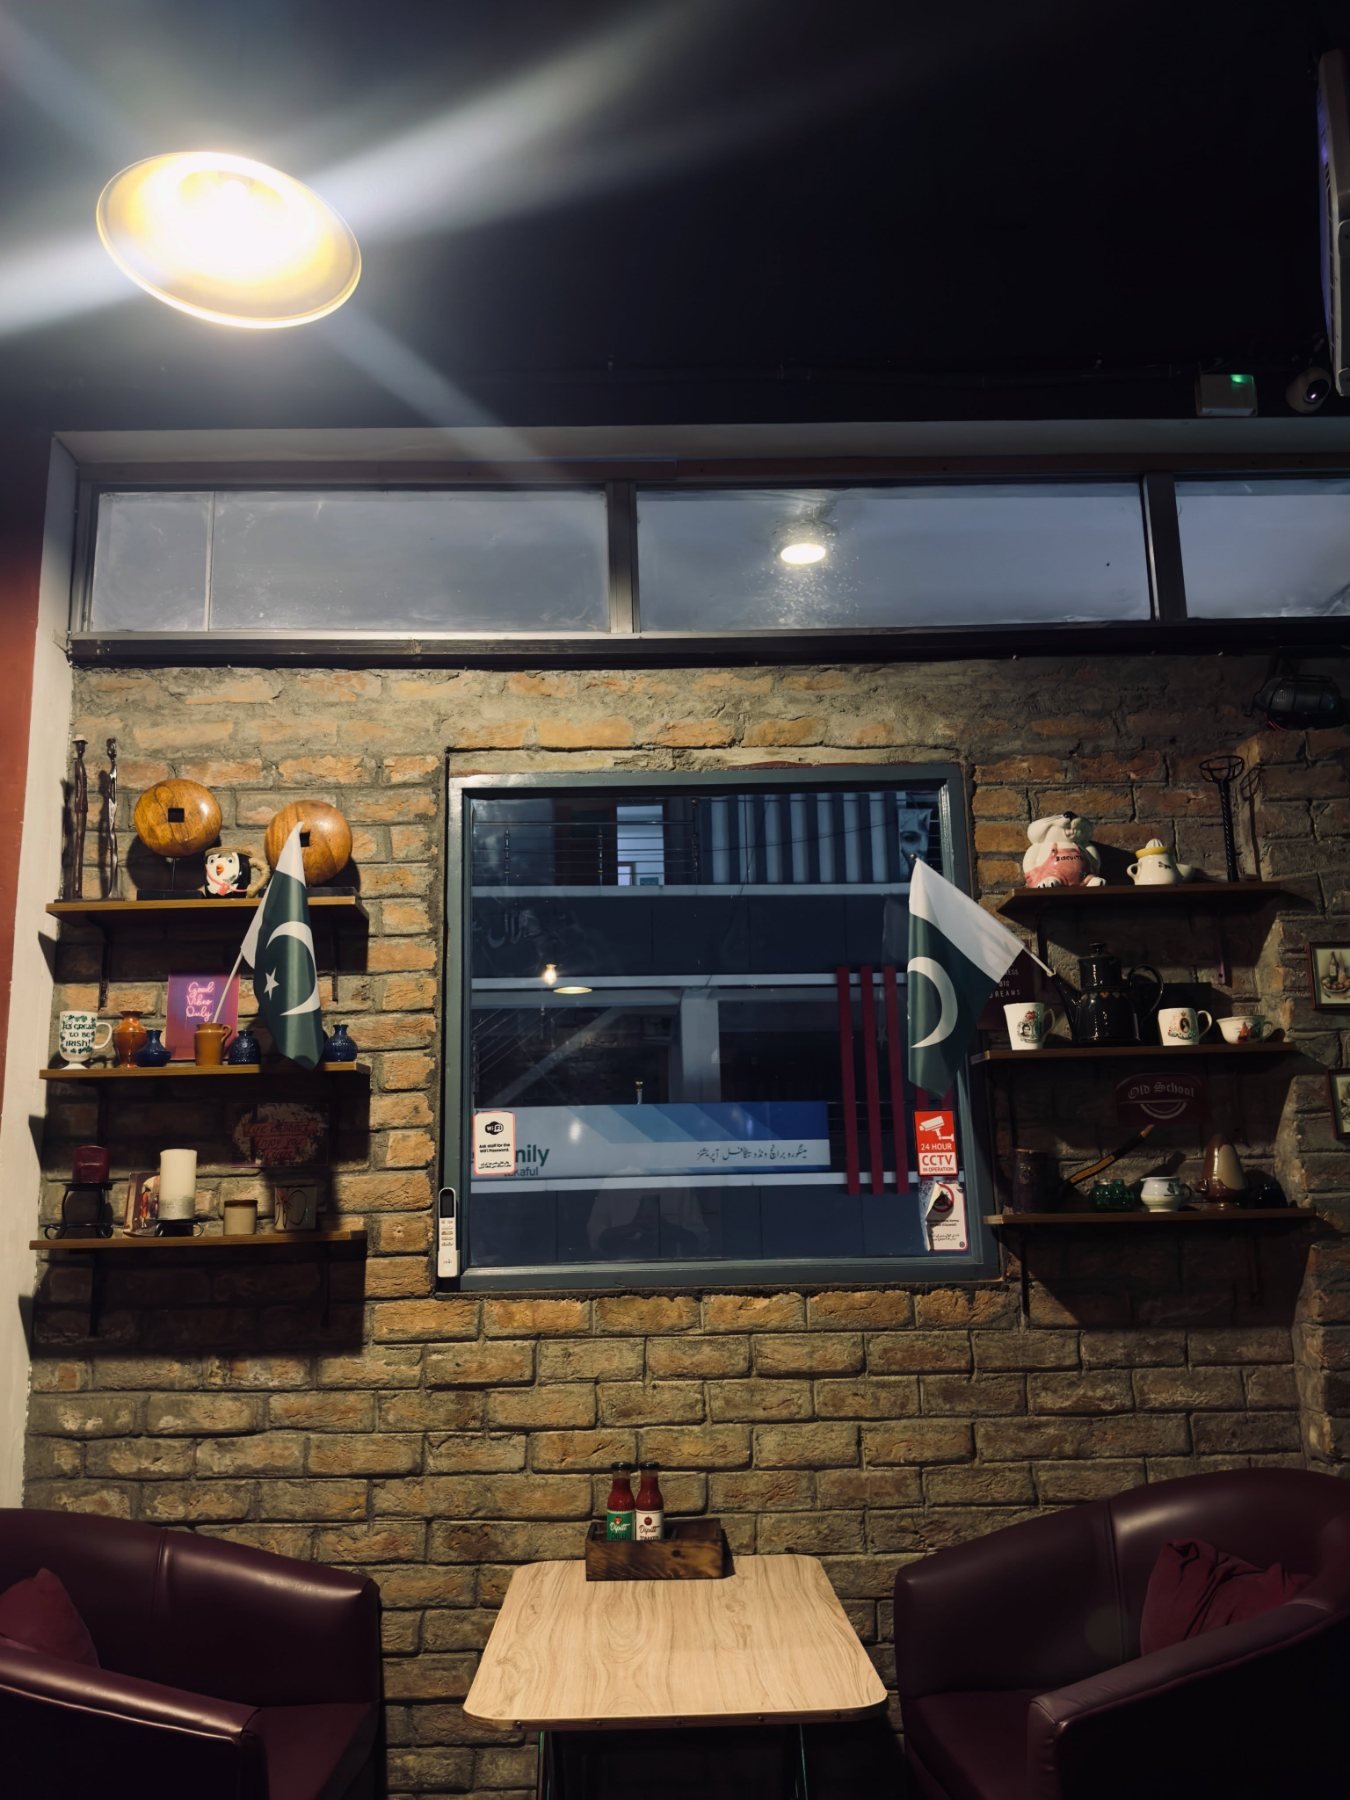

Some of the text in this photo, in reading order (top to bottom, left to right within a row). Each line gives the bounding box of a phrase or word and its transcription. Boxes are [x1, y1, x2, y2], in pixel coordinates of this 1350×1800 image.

[188, 981, 215, 998] Good
[186, 994, 213, 1006] Vibes
[185, 1005, 213, 1022] Only
[1127, 1081, 1196, 1100] Old School
[921, 1142, 953, 1151] 24 HOUR
[921, 1154, 953, 1167] CCTV
